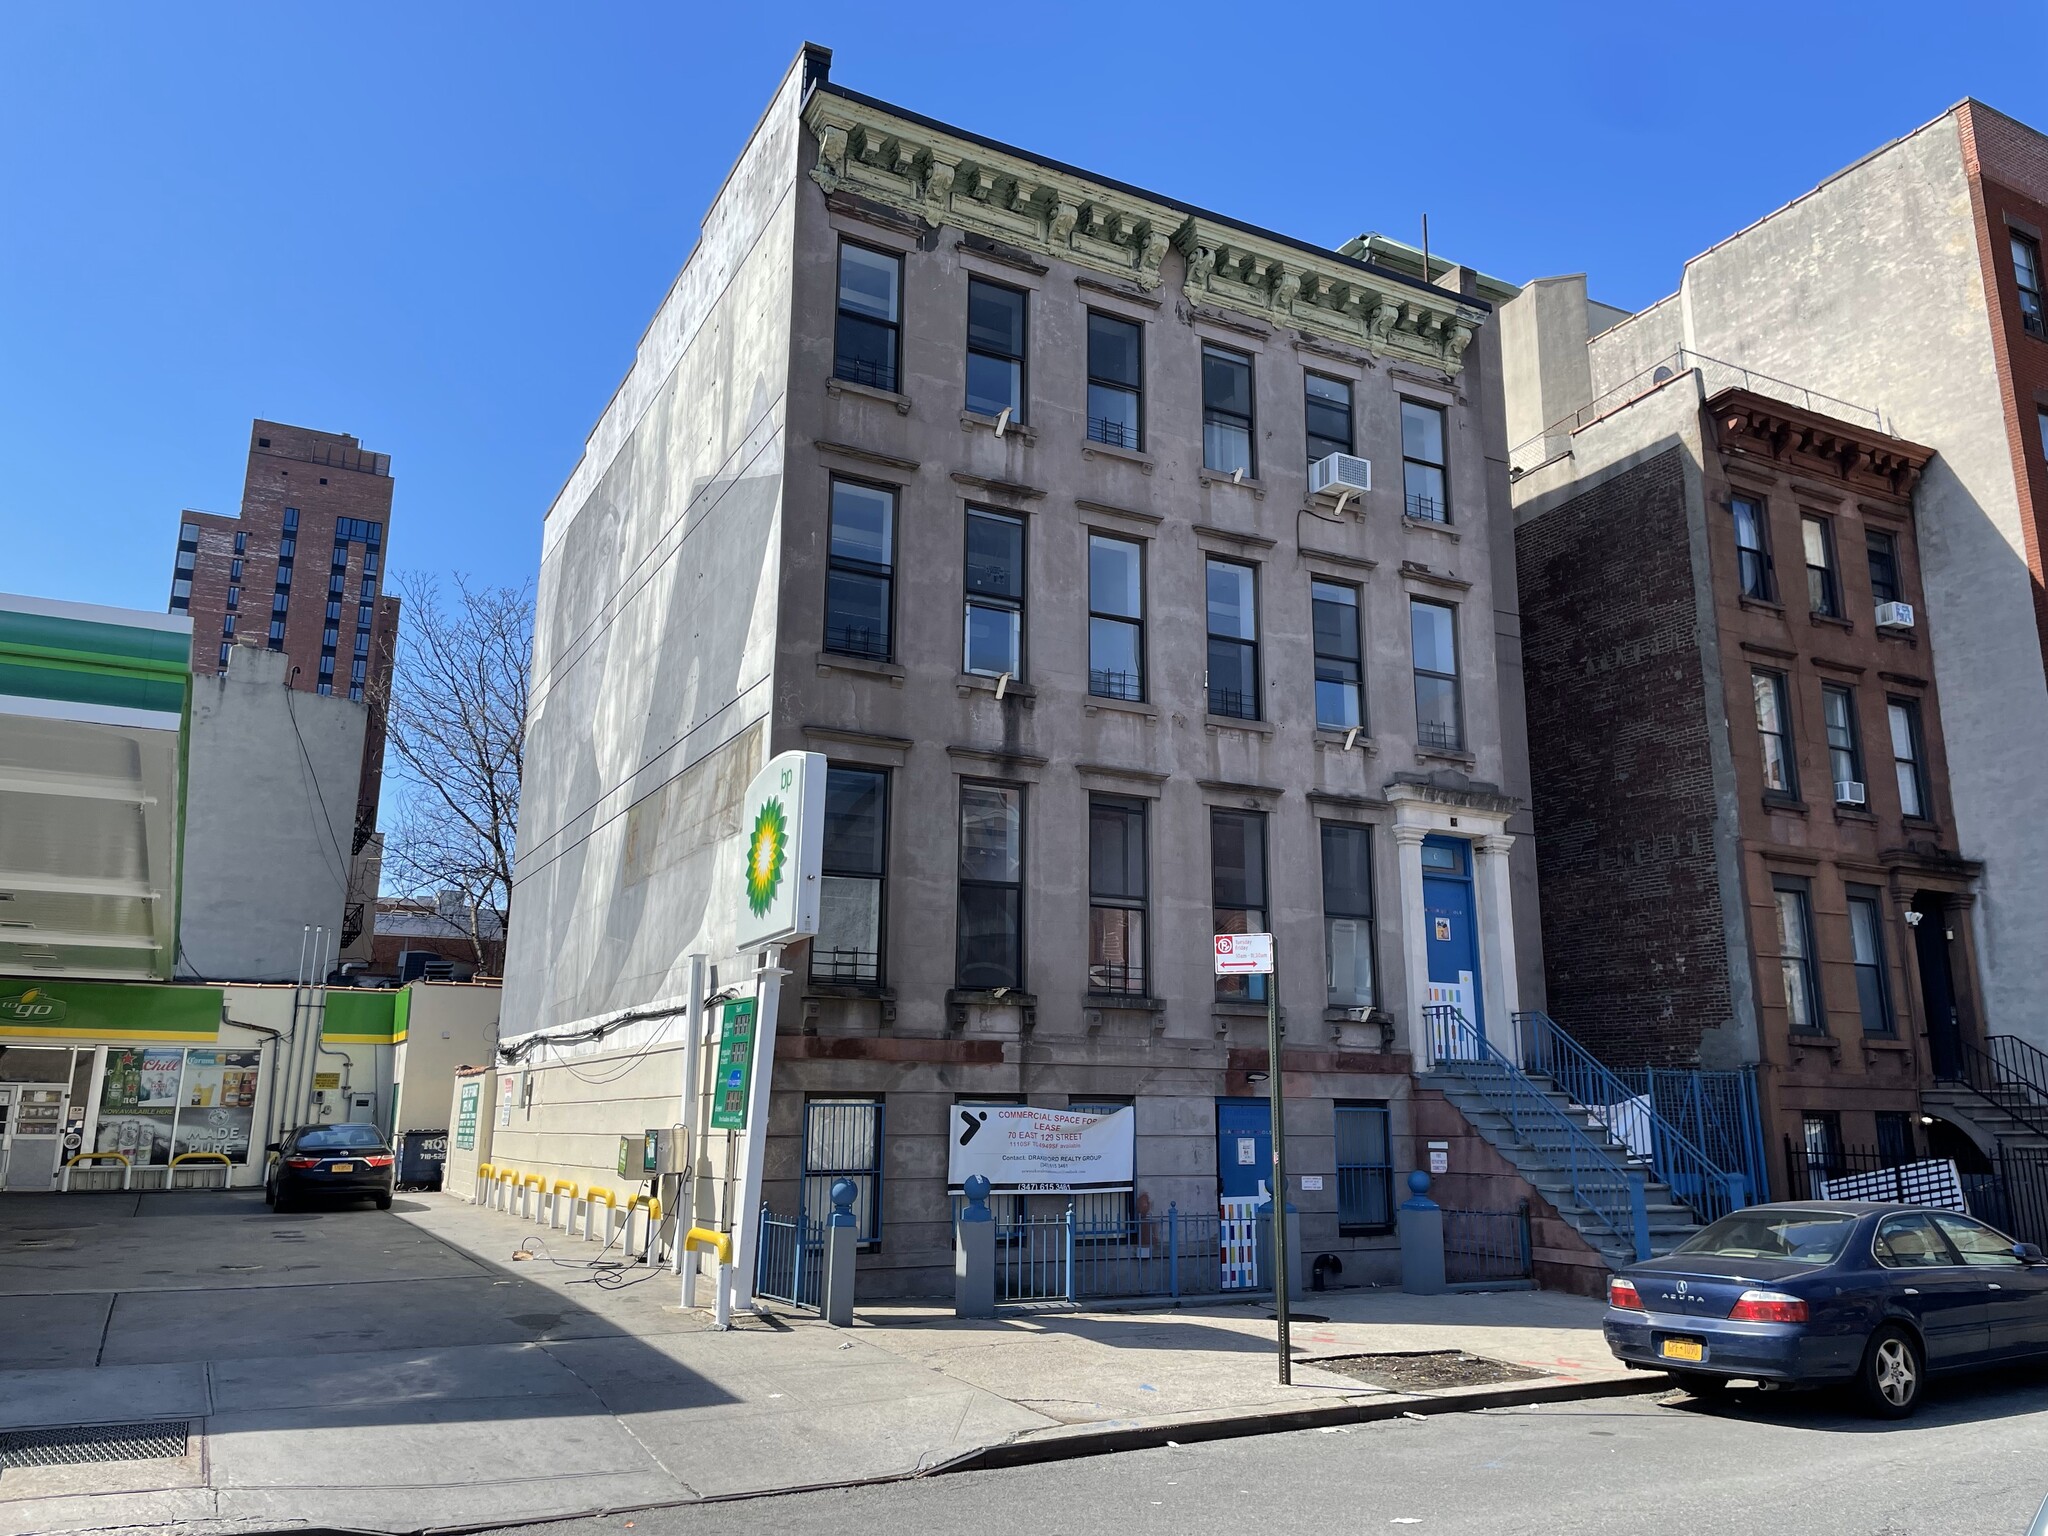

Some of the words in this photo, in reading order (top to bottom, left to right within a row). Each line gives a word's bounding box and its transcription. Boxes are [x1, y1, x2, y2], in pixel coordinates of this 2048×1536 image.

[780, 767, 792, 793] bp
[13, 1004, 53, 1018] go
[143, 1059, 179, 1071] Chill
[998, 1111, 1052, 1121] COMMERCIAL
[1054, 1114, 1080, 1124] SPACE
[1034, 1122, 1061, 1132] LEASE
[186, 1127, 240, 1140] MADE
[1008, 1131, 1017, 1139] 70
[1019, 1131, 1038, 1139] EAST
[1040, 1133, 1054, 1141] 129
[1056, 1132, 1083, 1141] STREET
[188, 1142, 233, 1154] PURE
[1082, 1154, 1102, 1162] GROUP
[1040, 1183, 1054, 1191] 615
[1662, 1293, 1705, 1302] ACURA
